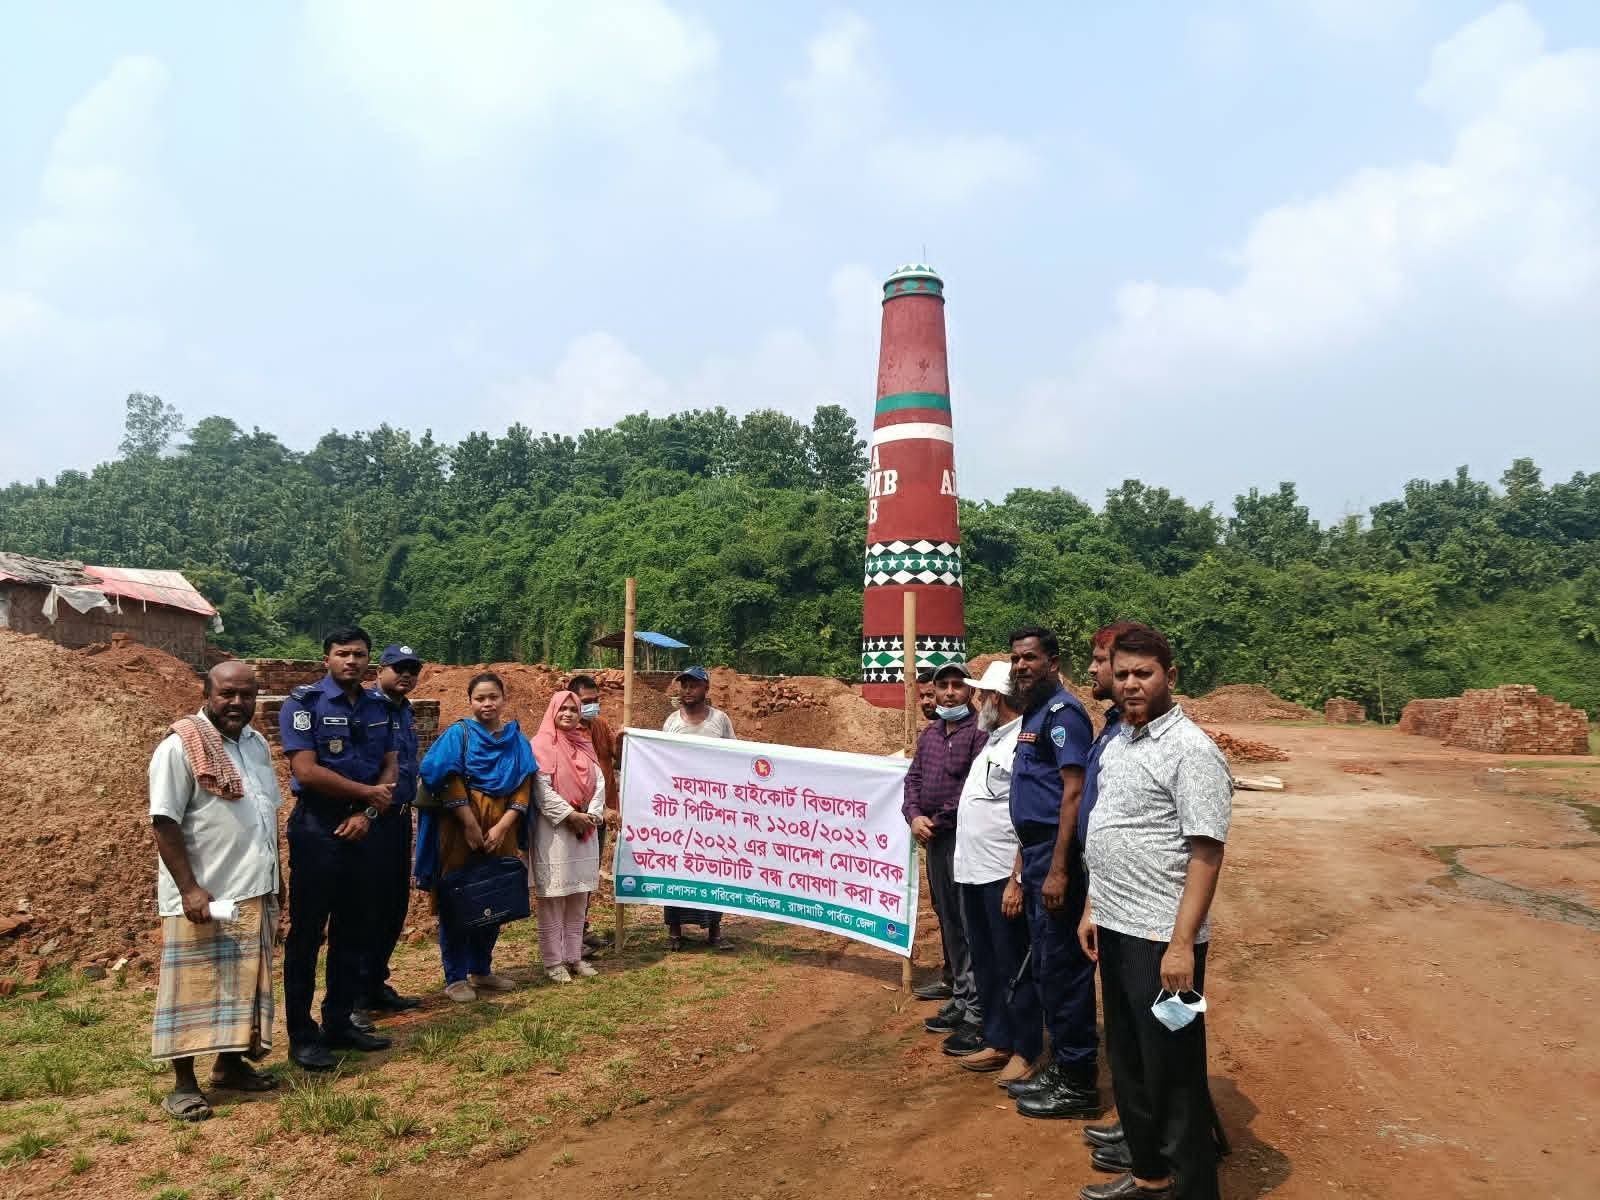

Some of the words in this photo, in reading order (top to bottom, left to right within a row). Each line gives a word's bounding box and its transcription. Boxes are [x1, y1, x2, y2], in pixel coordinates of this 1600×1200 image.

[651, 794, 679, 817] রীট
[683, 798, 737, 826] পিটিশন
[742, 811, 762, 832] নং
[767, 815, 869, 850] ১২০৪/২০২২
[875, 833, 888, 850] ও
[672, 776, 728, 800] মহামান্য
[733, 781, 797, 808] হাইকোর্ট
[802, 788, 868, 819] বিভাগের
[626, 825, 739, 855] ১৩৭০৫/২০২২
[744, 839, 768, 857] এর
[772, 842, 824, 867] আদেশ
[830, 852, 904, 883] মোতাবেক
[632, 848, 678, 872] অবৈধ
[683, 850, 754, 881] ইটভাটাটি
[758, 866, 783, 887] বন্ধ
[788, 871, 838, 897] ঘোষণা
[842, 881, 874, 905] করা
[878, 889, 901, 914] হল
[641, 882, 664, 895] জেলা
[666, 885, 697, 897] প্রশাসন
[700, 889, 707, 898] ও
[710, 887, 742, 905] পরিবেশ
[855, 917, 876, 934] জেলা
